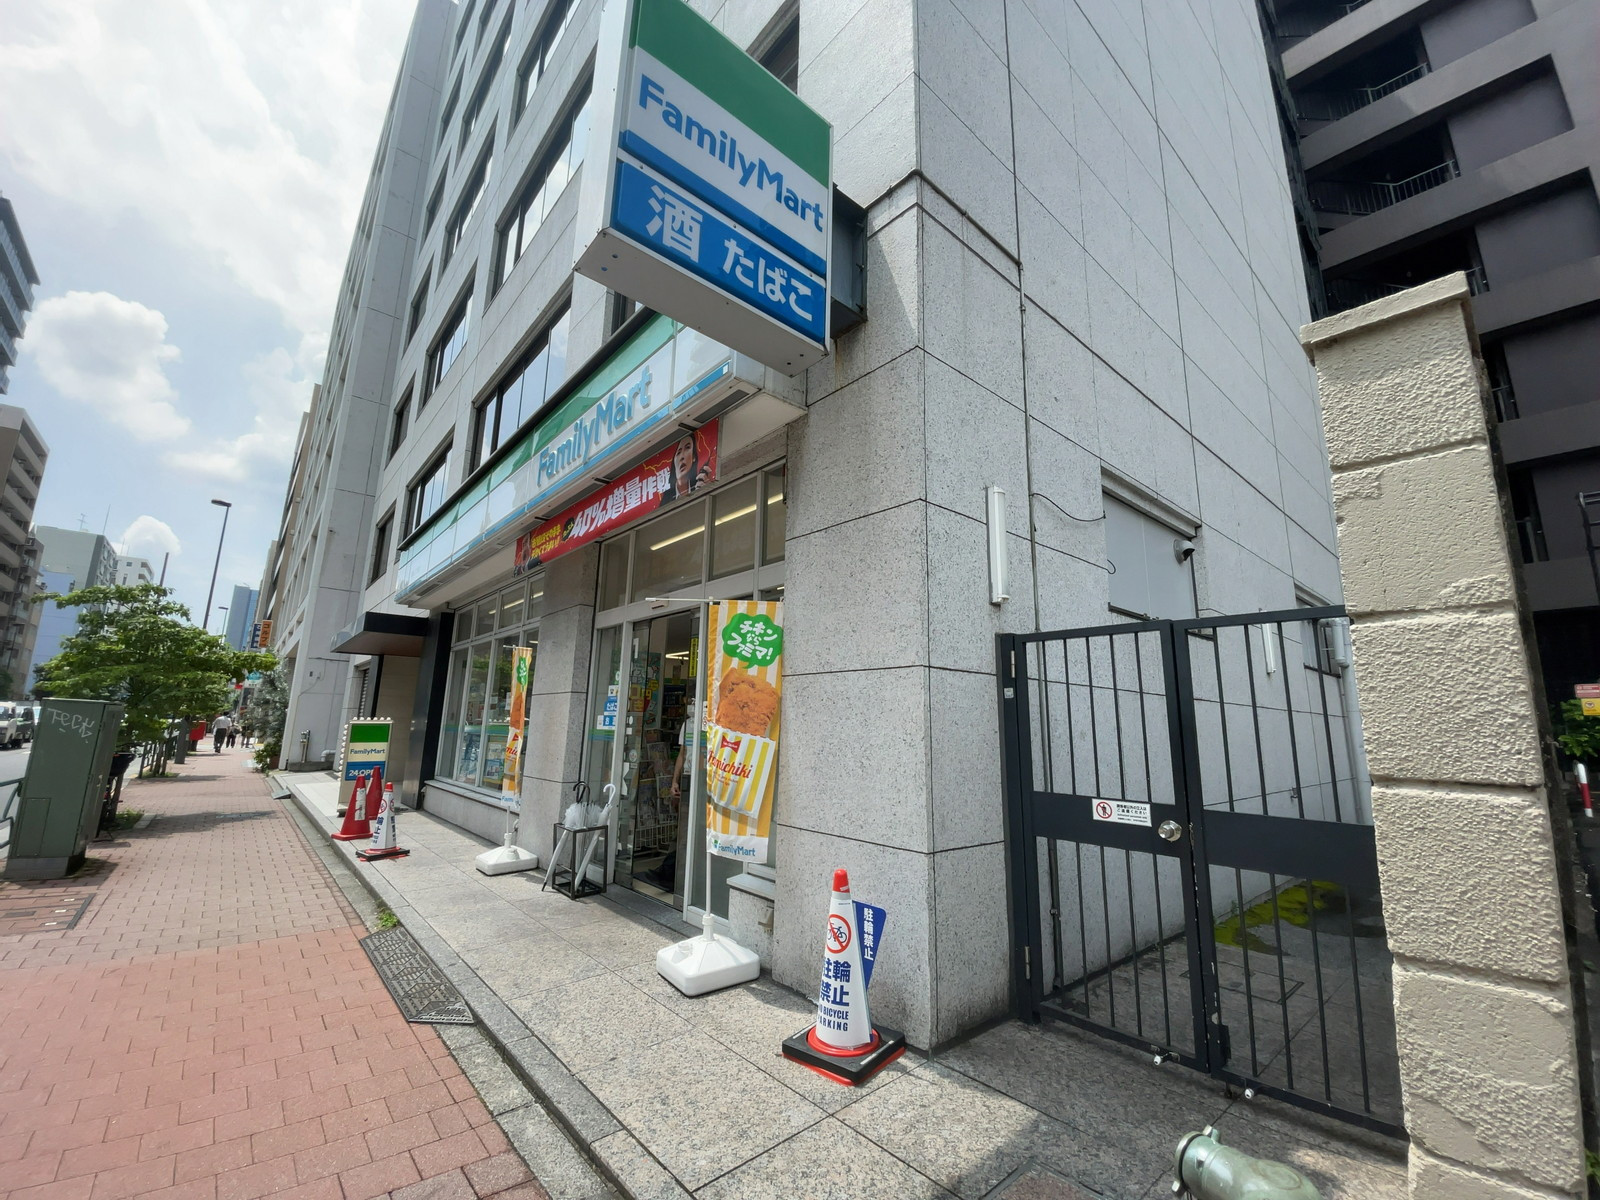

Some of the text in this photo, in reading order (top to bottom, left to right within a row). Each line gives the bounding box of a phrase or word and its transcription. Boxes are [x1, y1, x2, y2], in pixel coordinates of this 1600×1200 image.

[638, 73, 824, 233] FamilyMart
[645, 184, 813, 322] 酒 たばこ
[536, 364, 653, 487] FamilyMart
[739, 620, 778, 640] チキン
[746, 633, 762, 645] なら
[727, 632, 774, 660] ファミマ!
[351, 748, 386, 756] FamilyMart
[863, 907, 874, 961] 駐輪禁止
[818, 1015, 849, 1032] ARKING
[823, 1006, 849, 1020] BICYCLE
